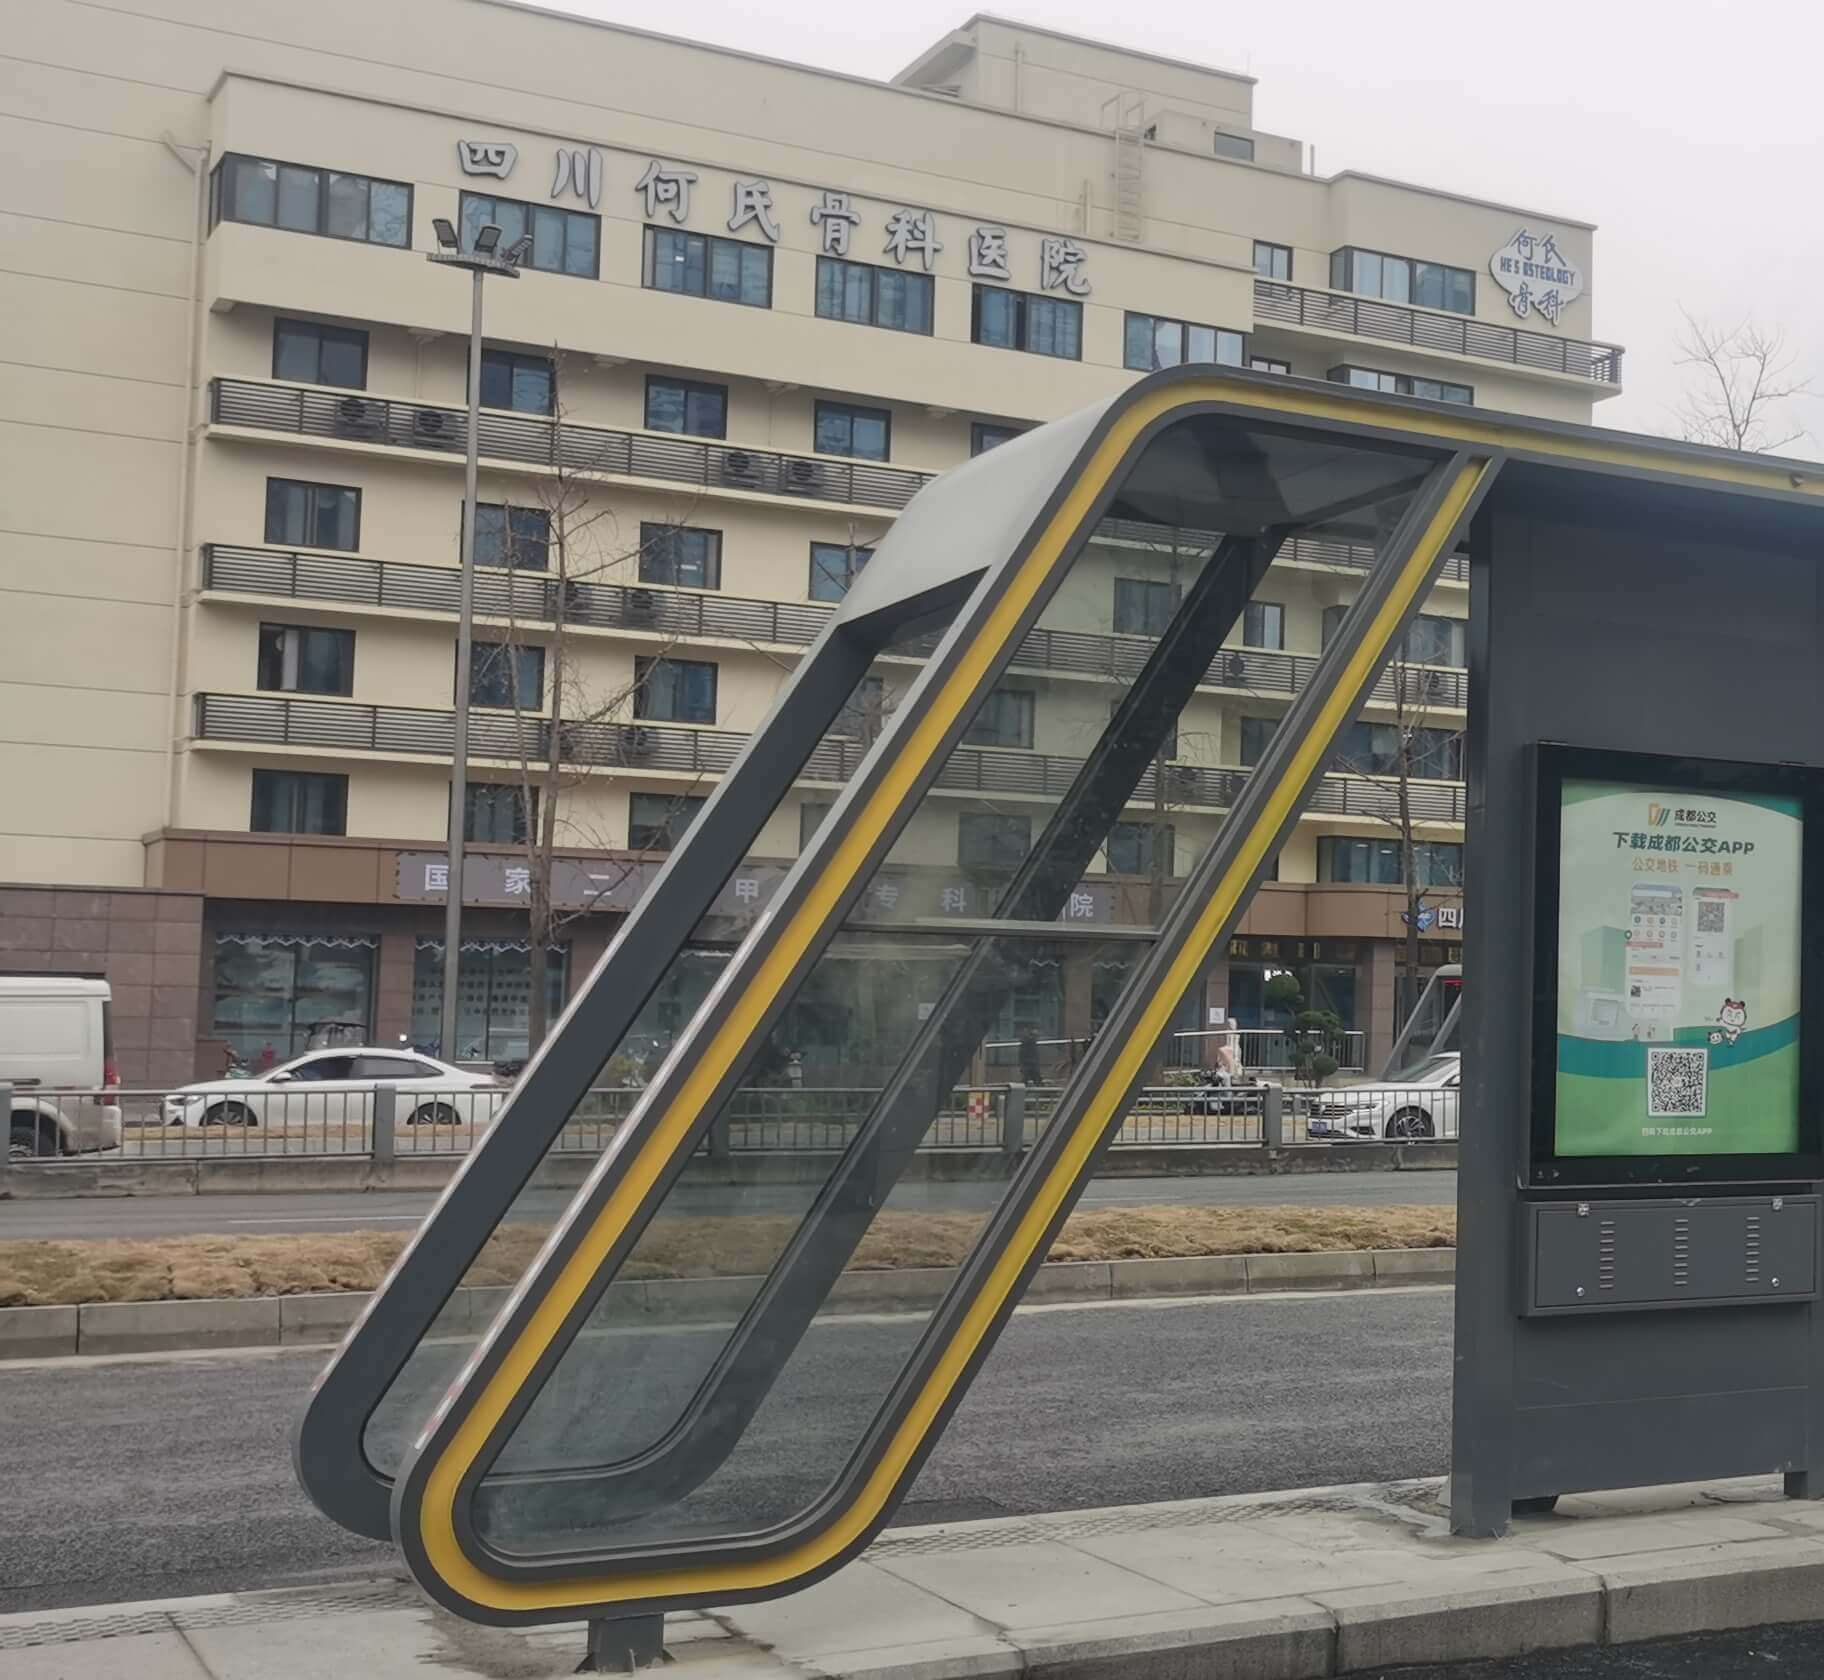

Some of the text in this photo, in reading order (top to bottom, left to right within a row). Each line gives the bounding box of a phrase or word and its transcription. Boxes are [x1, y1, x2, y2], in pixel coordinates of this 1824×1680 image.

[457, 139, 1093, 296] 四川何氏骨科医院
[1523, 260, 1576, 286] OSTEOLOGY
[1511, 281, 1564, 321] 骨科
[1674, 808, 1717, 824] 成都公交
[1612, 831, 1755, 855] 下载成都公交APP
